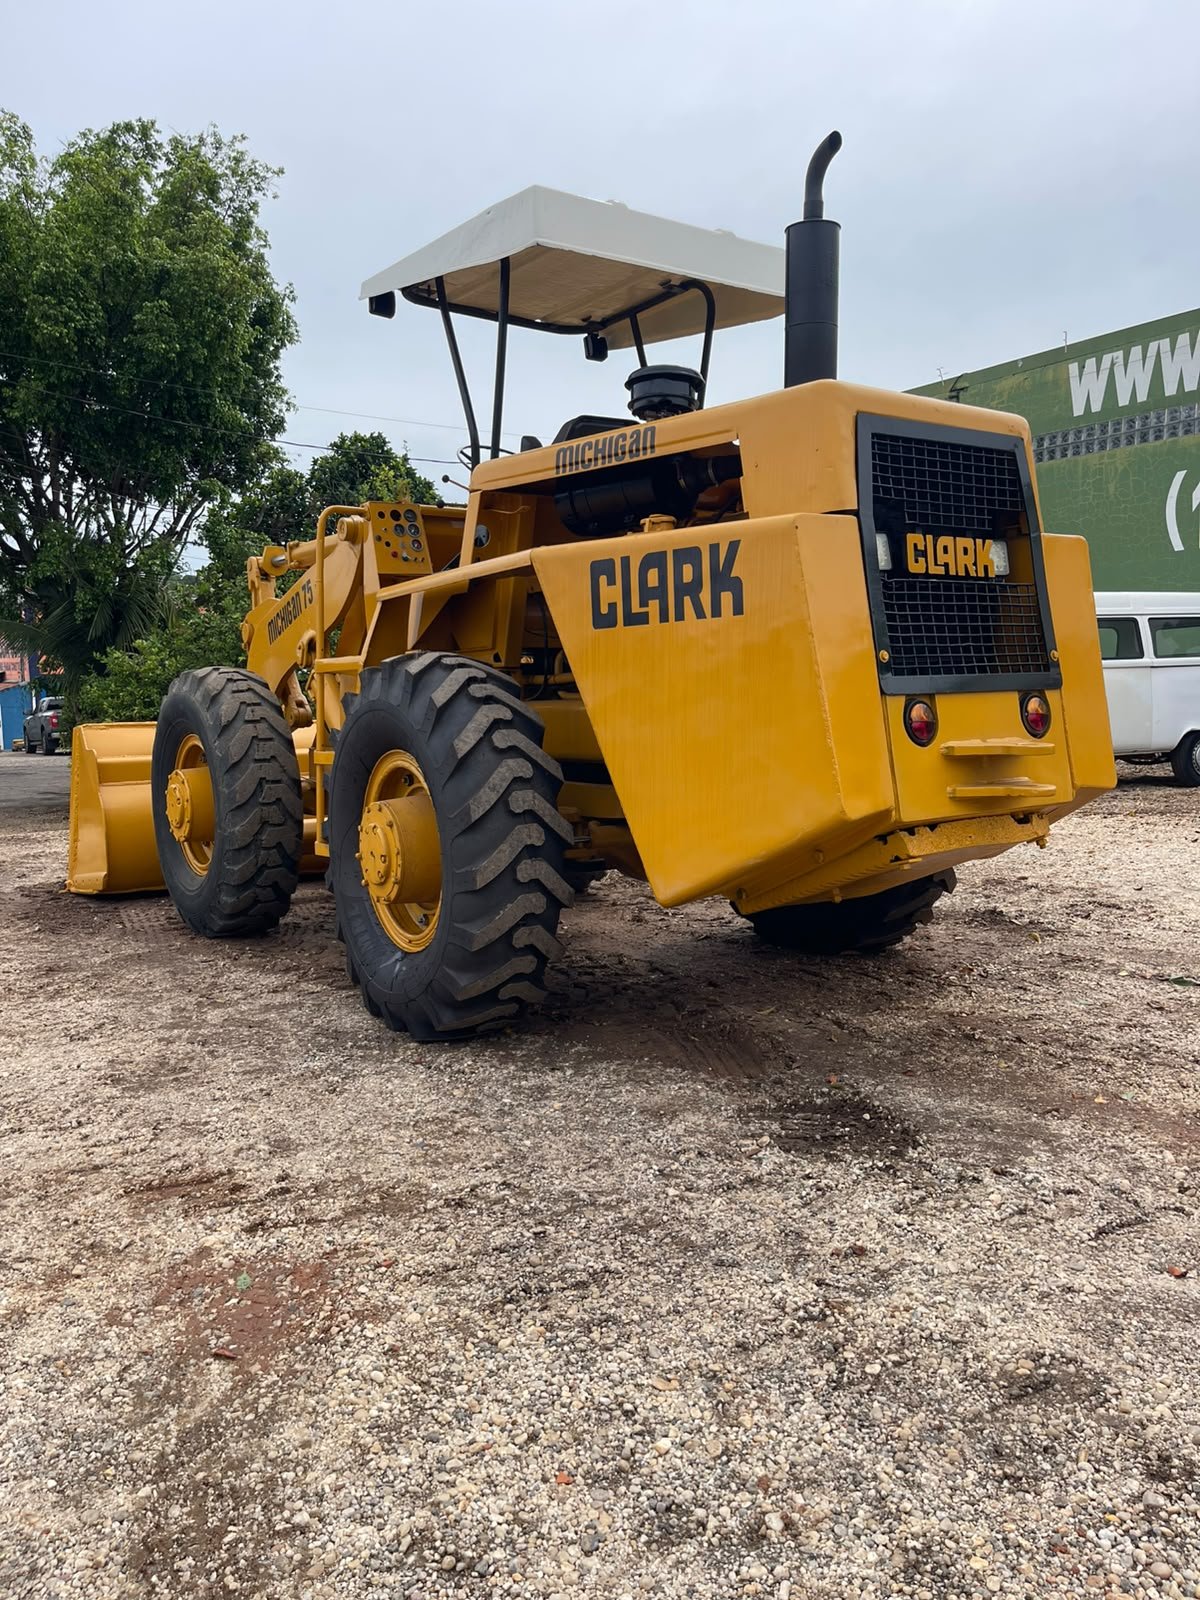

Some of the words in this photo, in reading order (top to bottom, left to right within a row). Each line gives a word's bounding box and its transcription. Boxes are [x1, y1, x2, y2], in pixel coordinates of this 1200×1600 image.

[906, 533, 996, 578] CLARK
[301, 578, 314, 609] 75
[590, 539, 744, 630] CLARK
